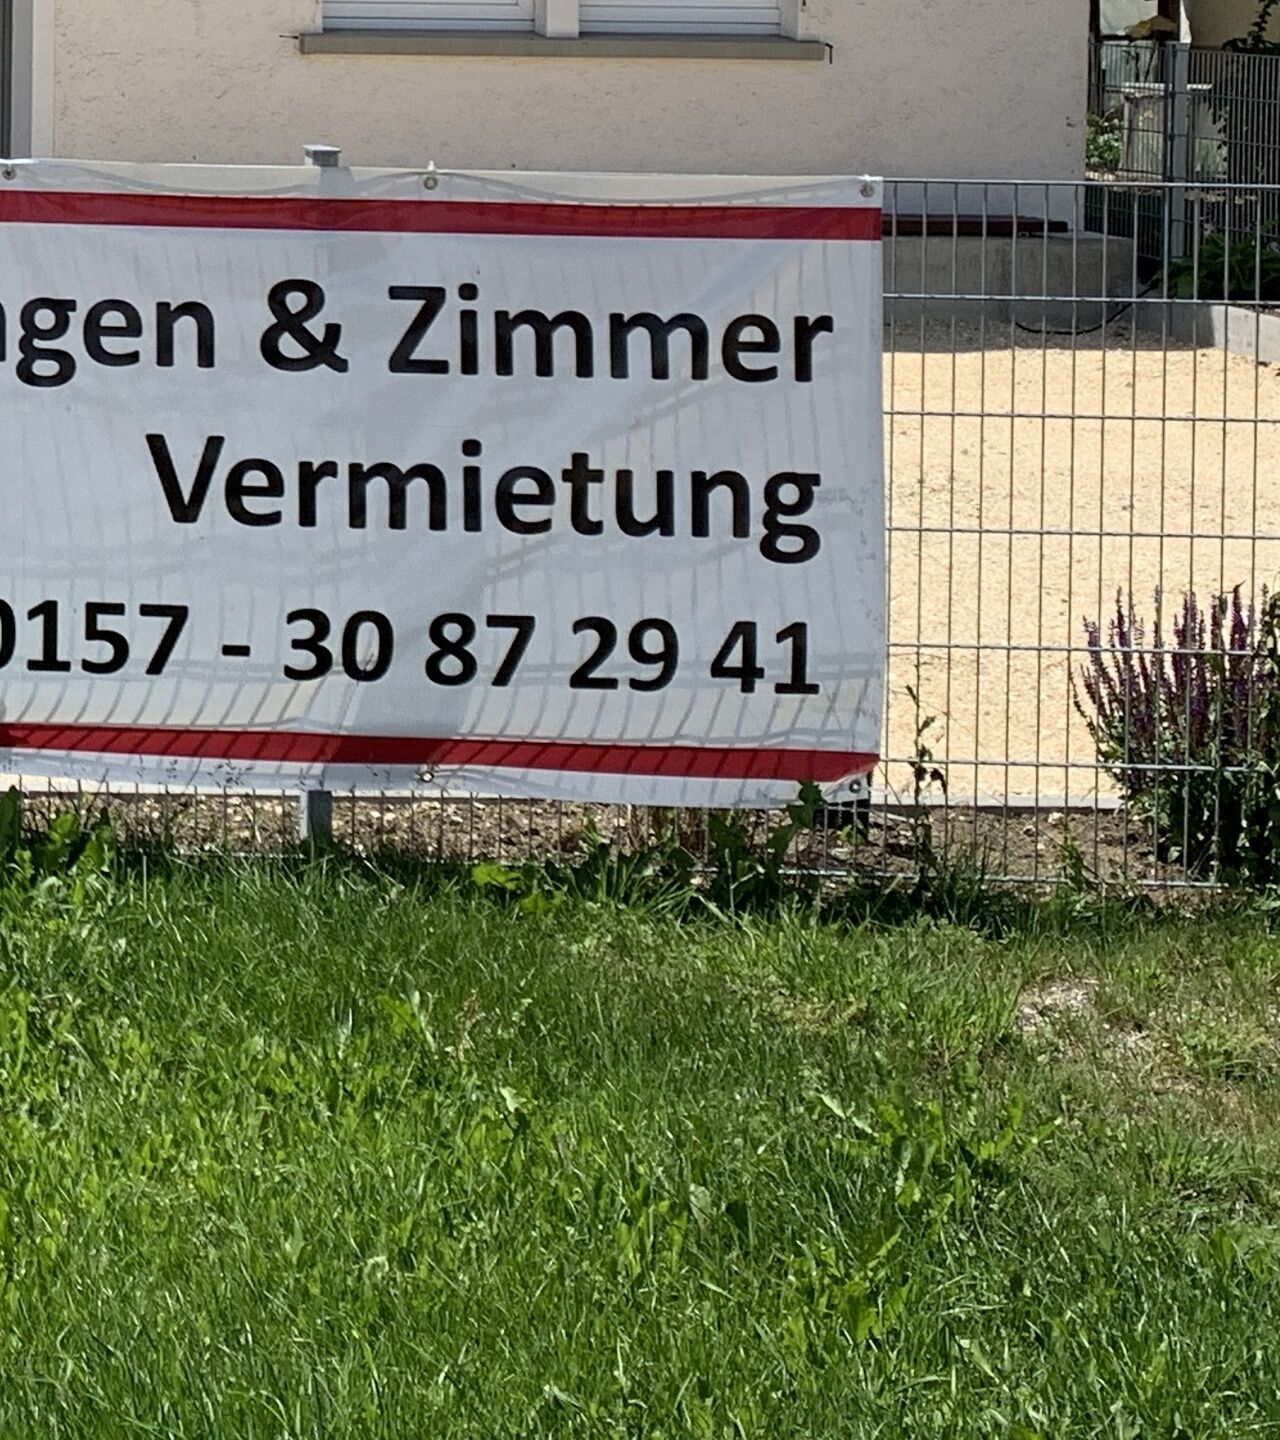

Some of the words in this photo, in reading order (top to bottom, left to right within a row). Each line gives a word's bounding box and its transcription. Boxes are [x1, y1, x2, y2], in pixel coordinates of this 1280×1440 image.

[260, 279, 348, 373] &
[389, 283, 833, 382] Zimmer
[146, 434, 820, 563] Vermietung
[284, 609, 393, 682] 30
[425, 613, 535, 686] 87
[570, 617, 678, 691] 29
[710, 621, 819, 694] 41
